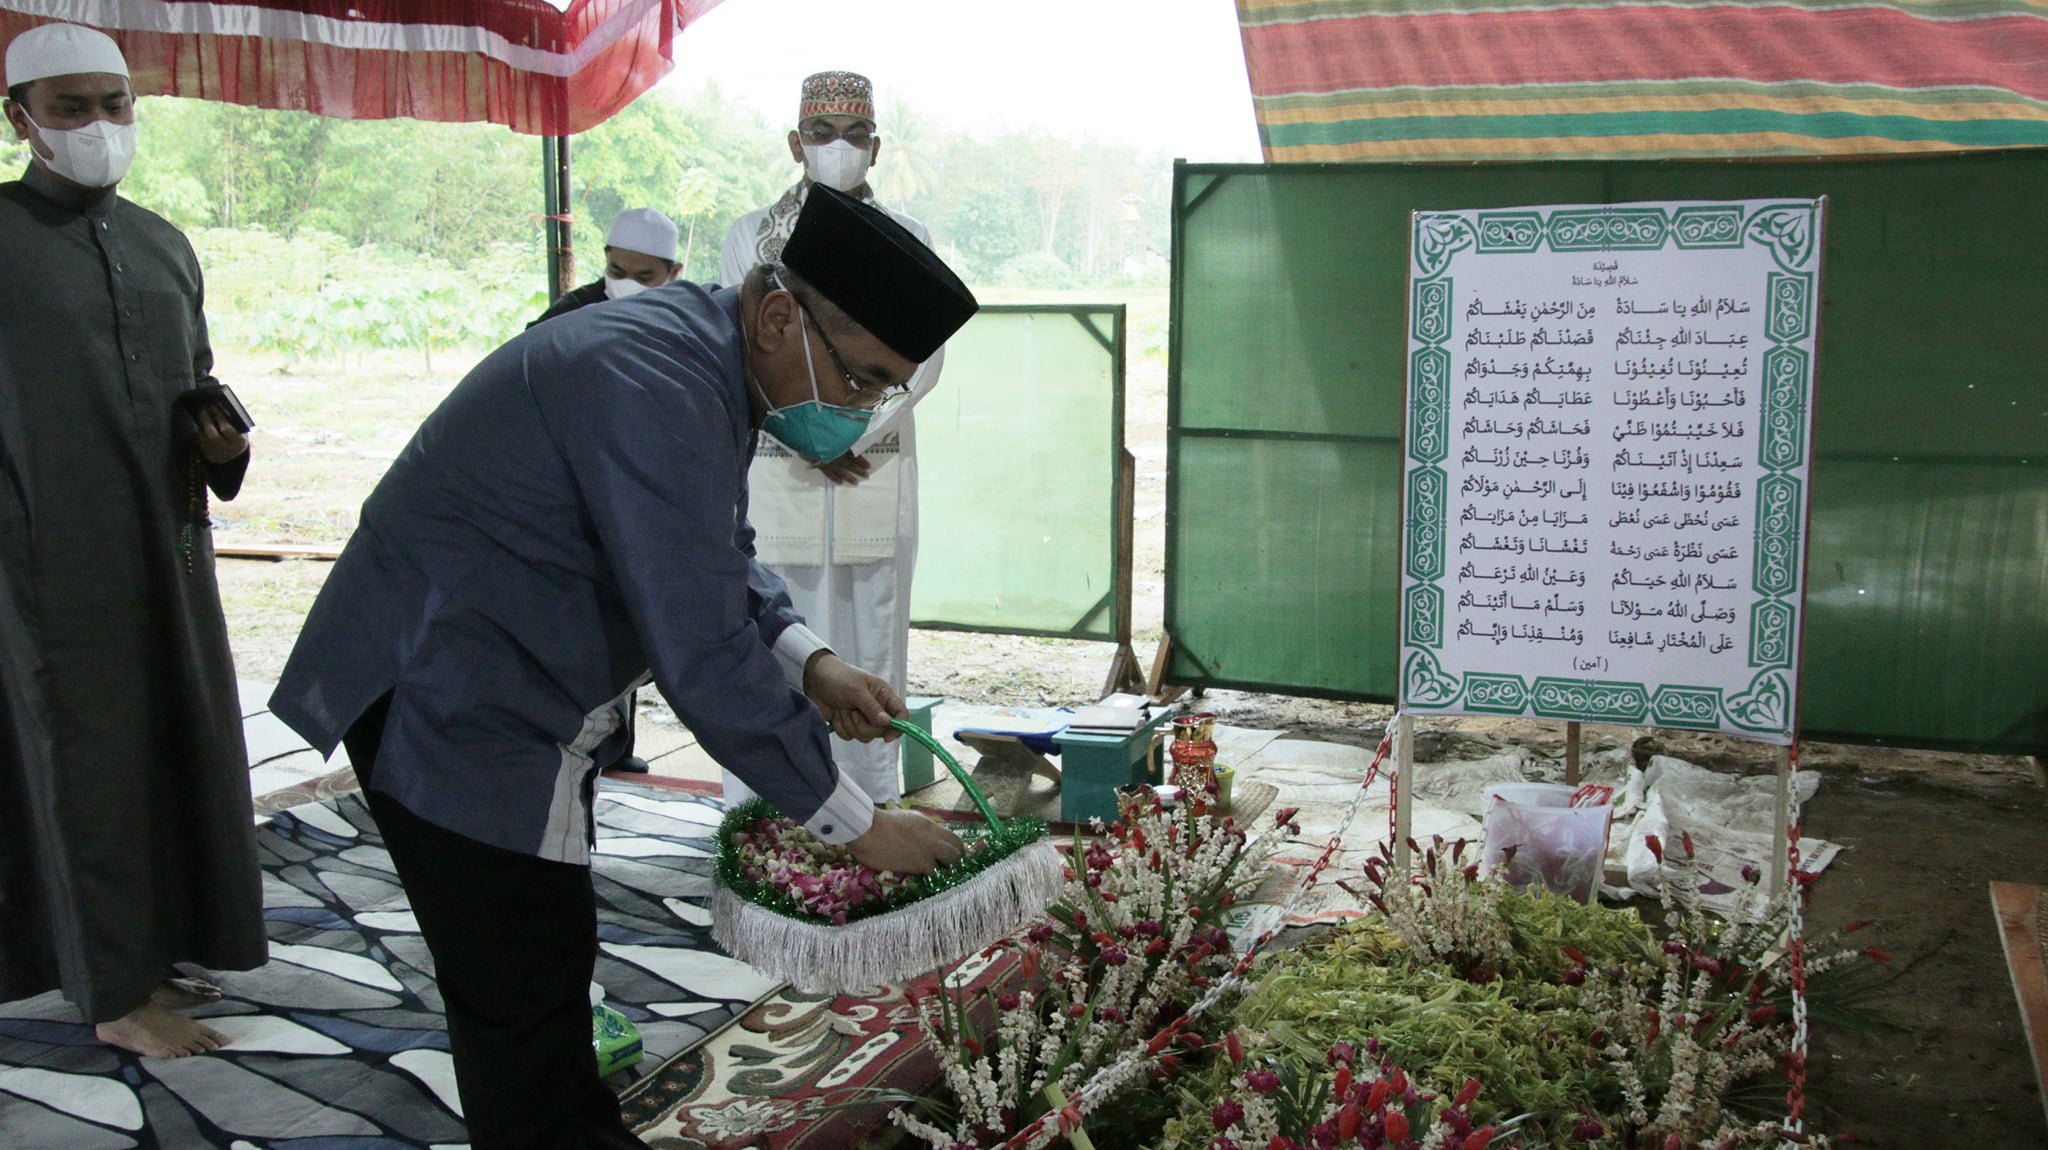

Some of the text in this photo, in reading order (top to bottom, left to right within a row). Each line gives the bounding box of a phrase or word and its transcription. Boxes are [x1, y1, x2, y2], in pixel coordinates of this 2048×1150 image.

[1577, 303, 1595, 319] مِنَ
[1673, 300, 1686, 317] يَا
[1519, 509, 1538, 527] مِنْ
[1511, 596, 1540, 610] مَا
